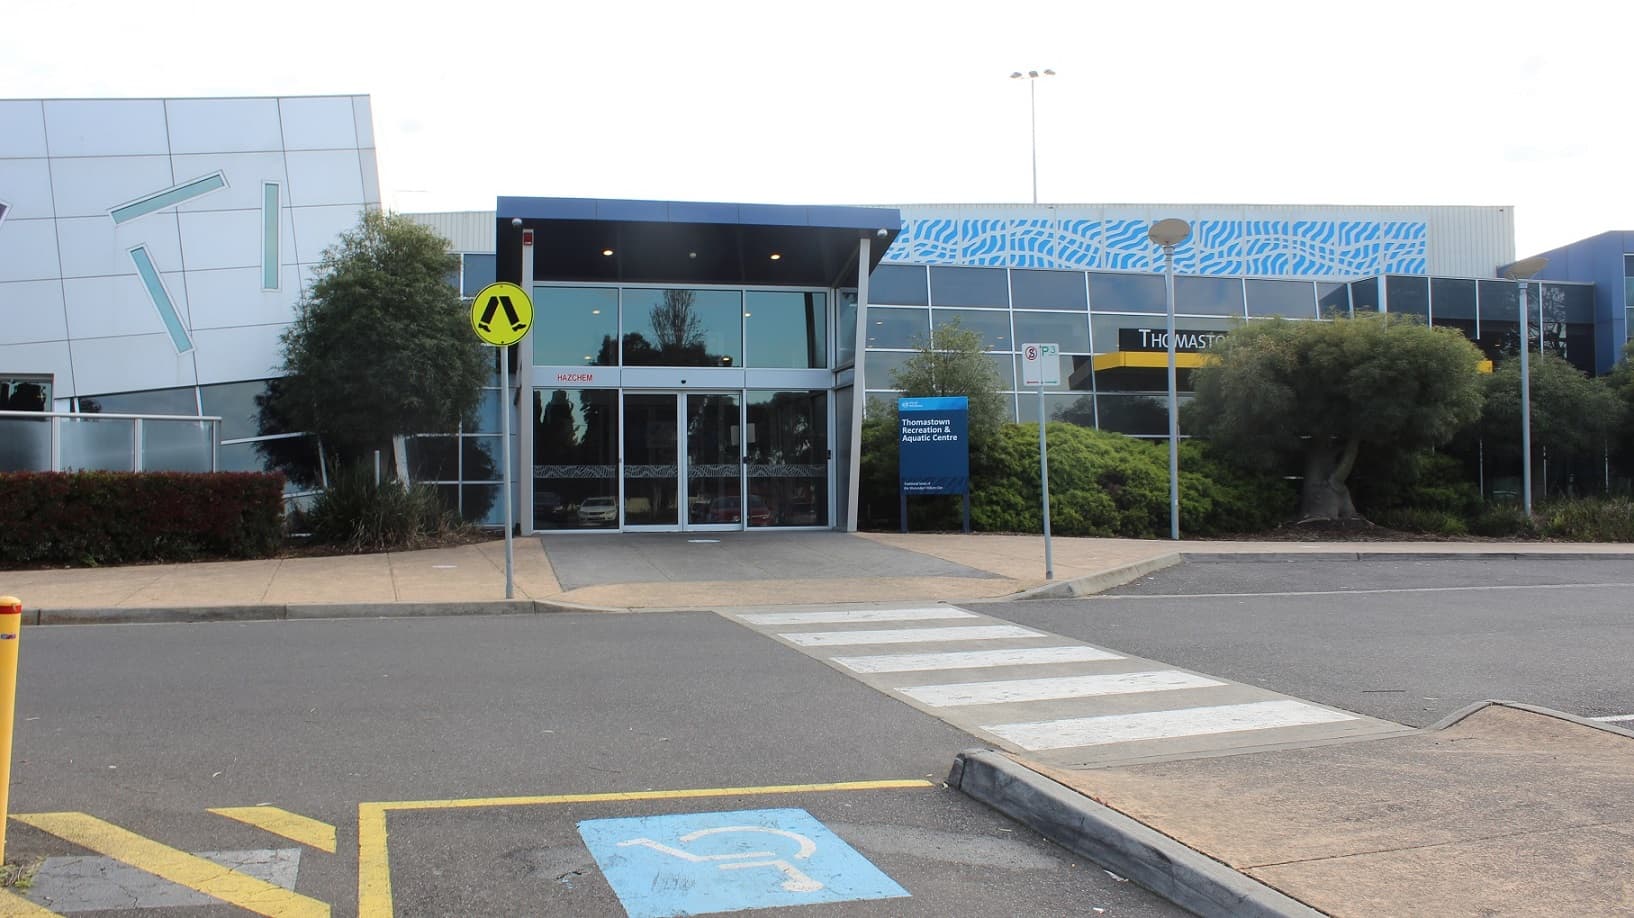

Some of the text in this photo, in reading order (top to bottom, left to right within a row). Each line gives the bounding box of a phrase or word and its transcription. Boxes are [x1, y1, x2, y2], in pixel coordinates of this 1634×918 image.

[1138, 328, 1227, 349] THOMASTO
[557, 374, 593, 382] HAZCHEM
[902, 426, 942, 434] Recreation
[902, 434, 930, 443] Aquatic
